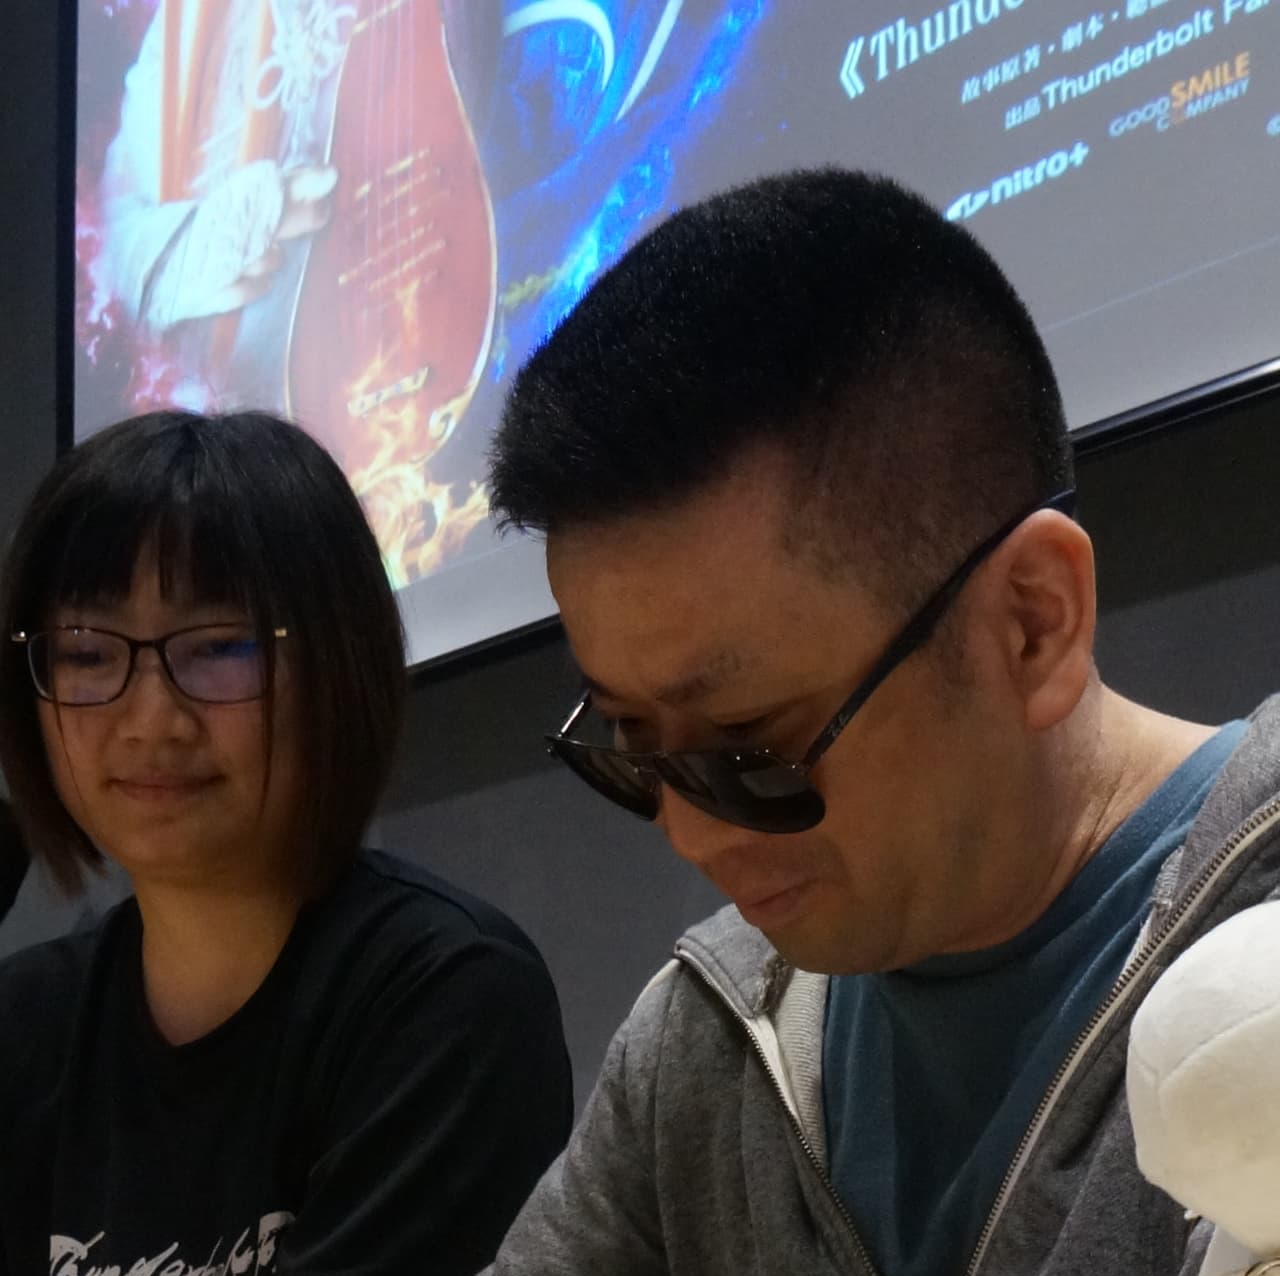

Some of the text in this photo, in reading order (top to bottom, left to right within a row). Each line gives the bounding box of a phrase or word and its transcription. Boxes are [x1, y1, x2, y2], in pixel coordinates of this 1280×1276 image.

[1042, 8, 1214, 110] Thunderbolt
[1109, 51, 1250, 137] GOOD SMILE
